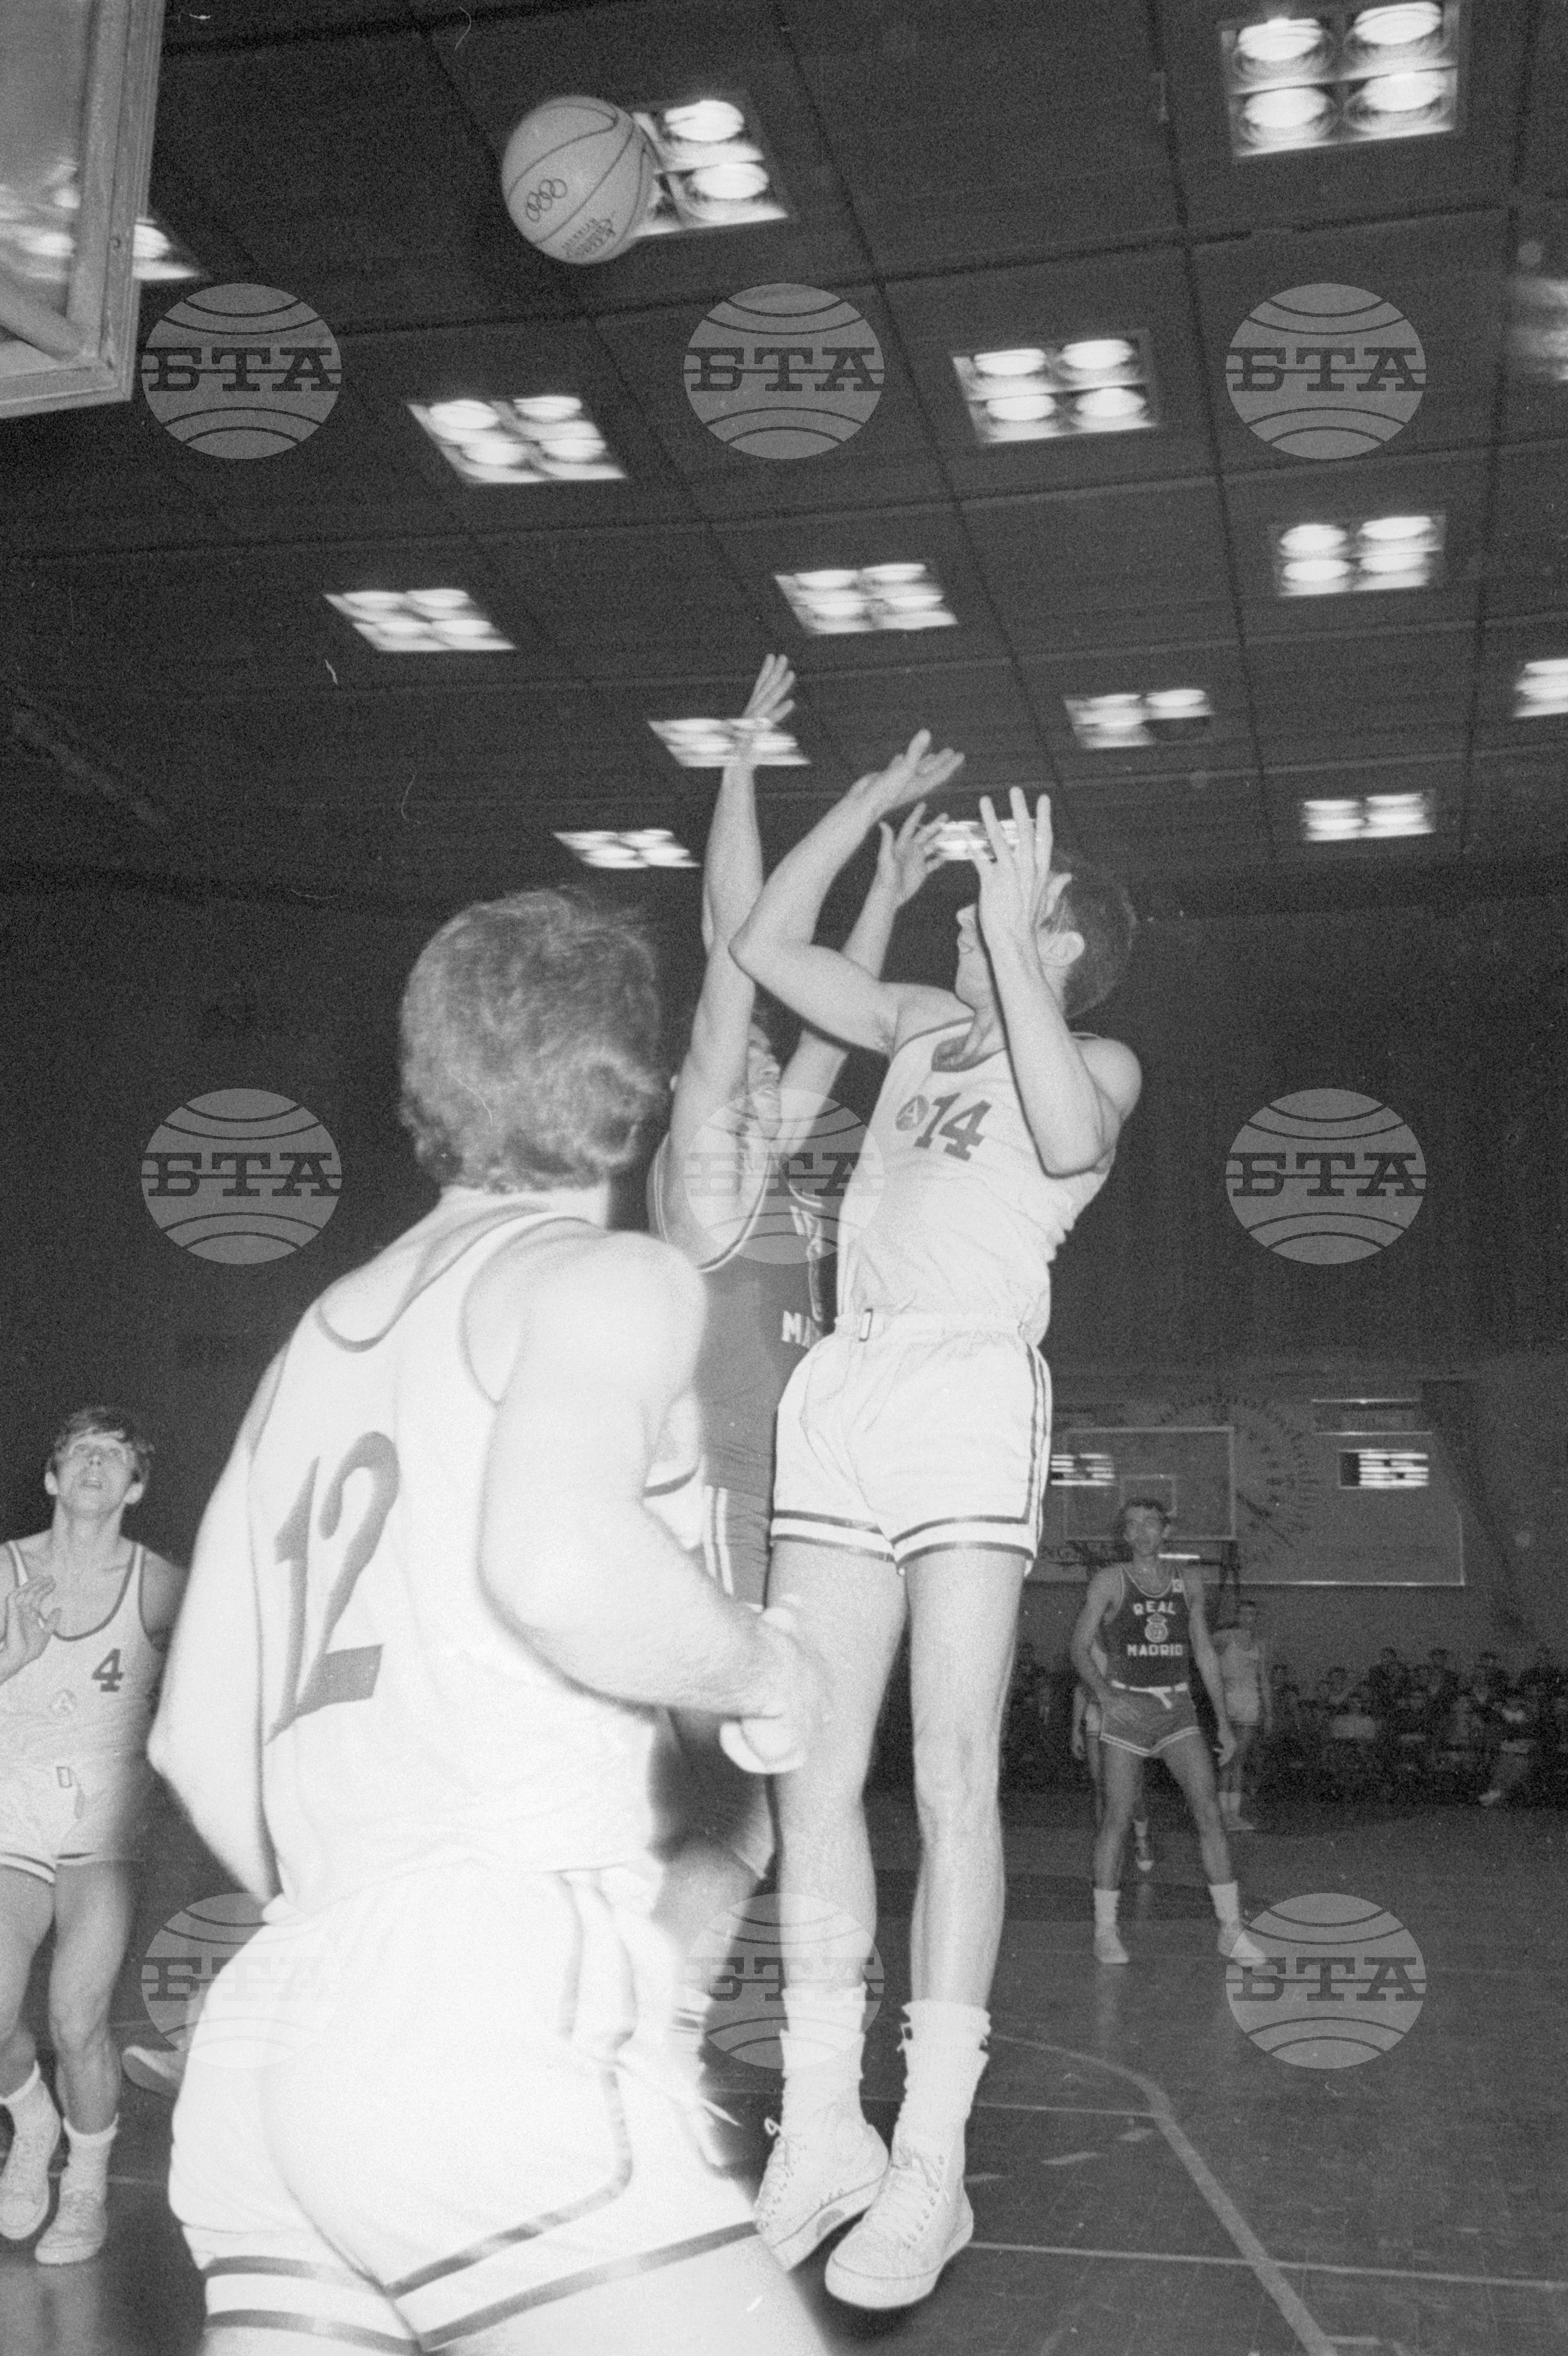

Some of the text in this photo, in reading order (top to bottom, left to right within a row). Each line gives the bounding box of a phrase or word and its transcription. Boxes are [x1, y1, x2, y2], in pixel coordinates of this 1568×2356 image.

[914, 1091, 993, 1161] 14
[268, 1431, 400, 1742] 12
[1133, 1601, 1176, 1616] REAL
[92, 1648, 124, 1692] 4
[1127, 1644, 1183, 1656] MADRID
